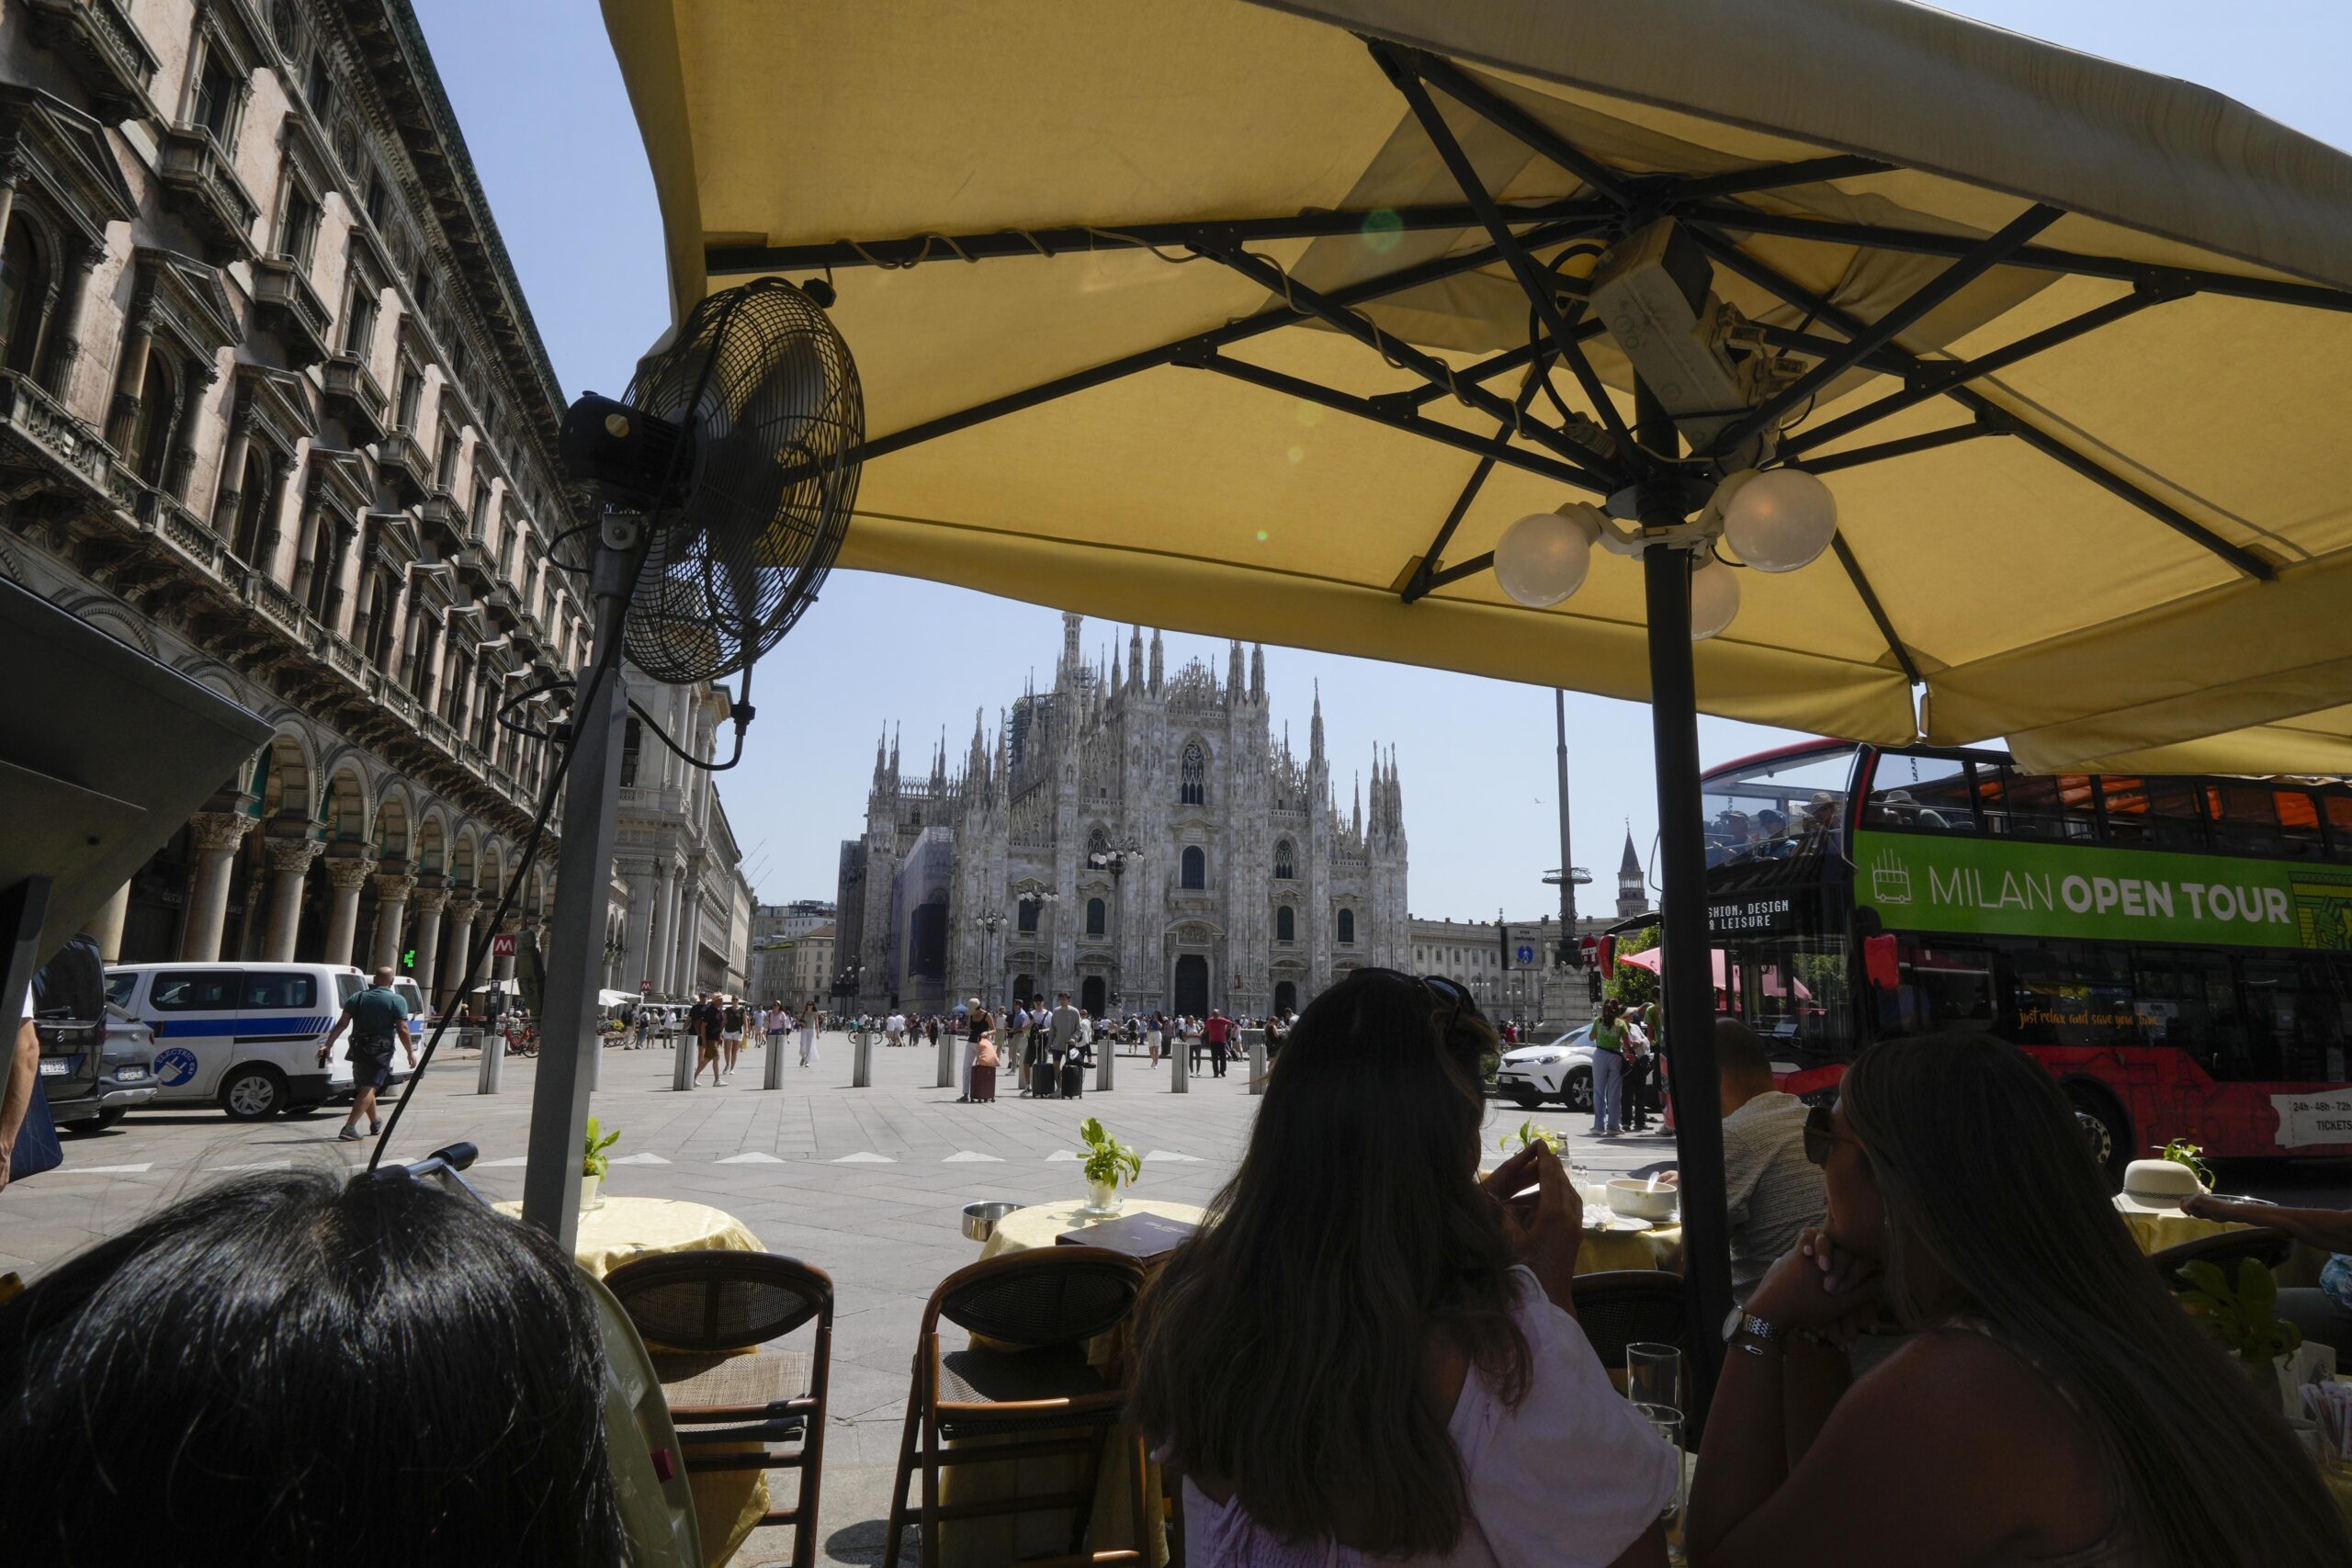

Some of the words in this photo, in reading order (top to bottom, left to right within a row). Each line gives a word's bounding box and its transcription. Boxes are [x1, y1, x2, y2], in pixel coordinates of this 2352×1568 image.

[1928, 864, 2053, 912] MILAN
[2061, 874, 2175, 919] OPEN
[2180, 882, 2290, 924] TOUR
[1747, 899, 1790, 915] DESIGN
[1721, 915, 1771, 930] LEISURE
[495, 939, 514, 952] M
[641, 982, 651, 990] M
[2018, 1006, 2040, 1029] just
[2040, 1008, 2066, 1025] relax
[2069, 1009, 2088, 1025] and
[2091, 1013, 2113, 1025] save
[155, 1049, 194, 1064] ELECTRIC
[2293, 1101, 2309, 1111] 24h
[2314, 1101, 2330, 1111] 48h
[2335, 1101, 2351, 1111] 72h
[2316, 1120, 2352, 1131] TICKETS
